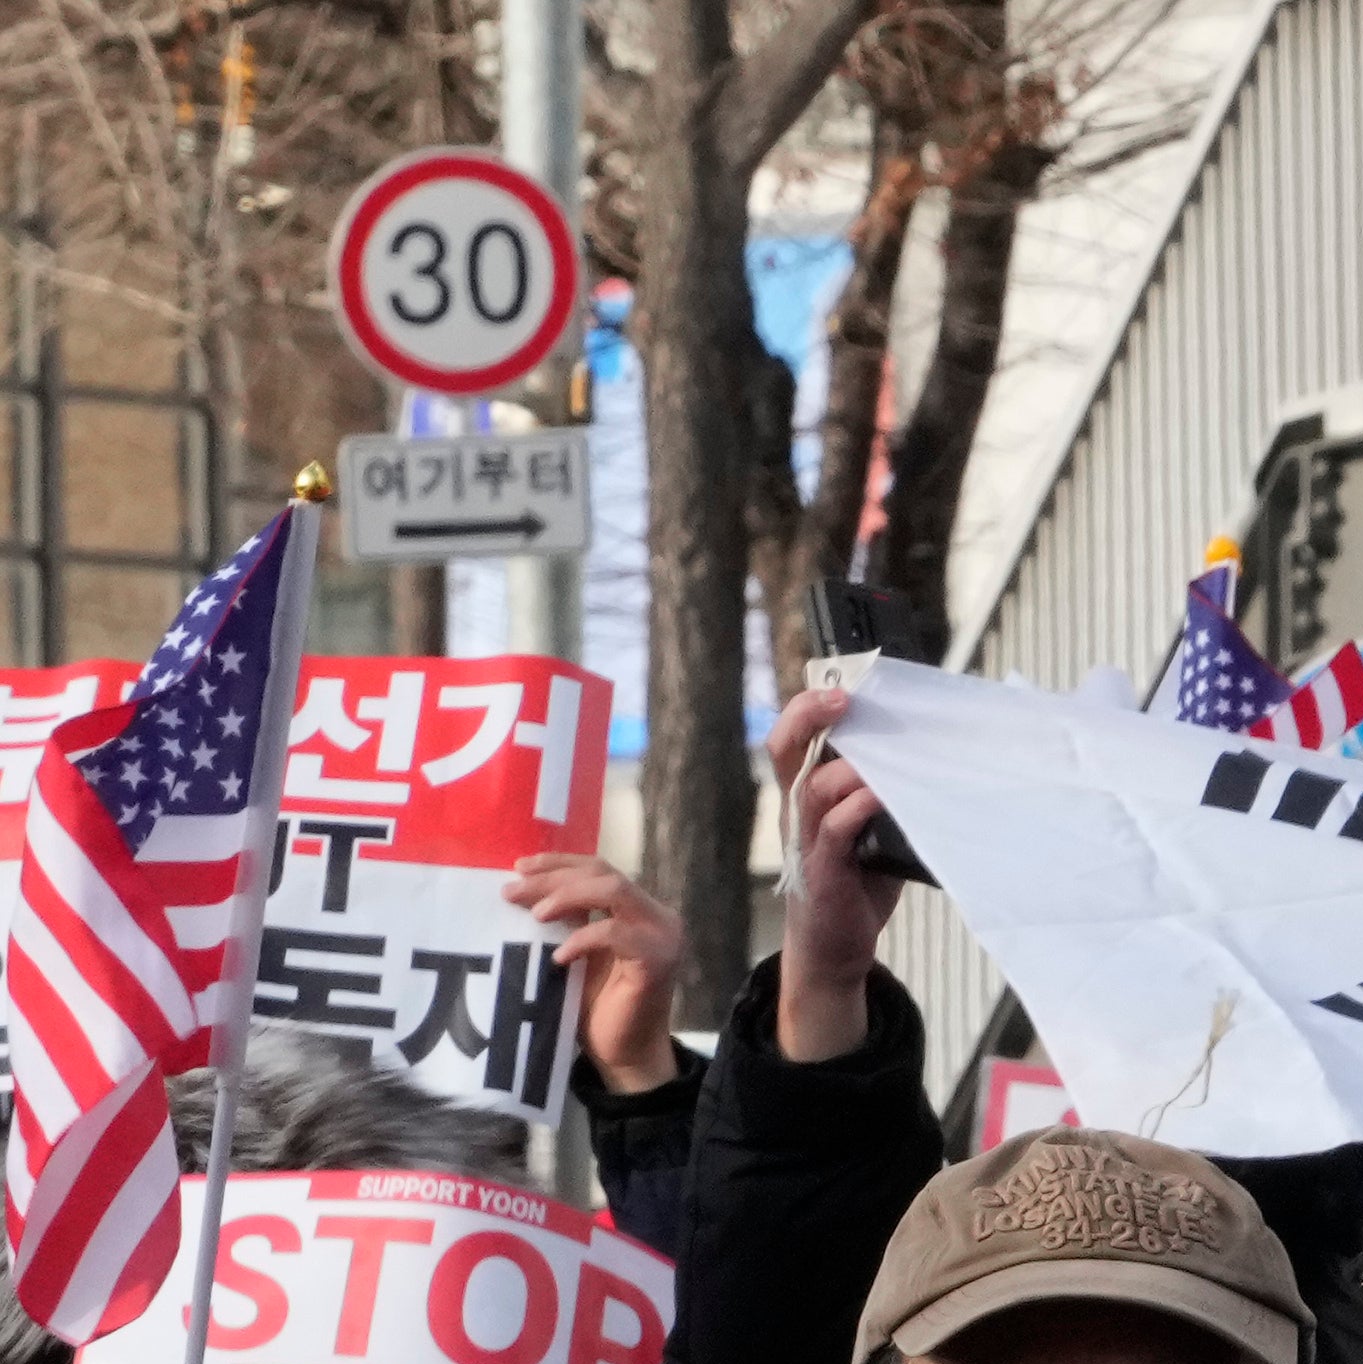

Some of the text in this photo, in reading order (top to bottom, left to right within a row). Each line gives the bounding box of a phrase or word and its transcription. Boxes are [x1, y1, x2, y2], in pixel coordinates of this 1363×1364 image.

[388, 221, 530, 327] 30
[364, 450, 573, 506] 여기부터
[358, 1174, 547, 1225] SUPPORT YOON
